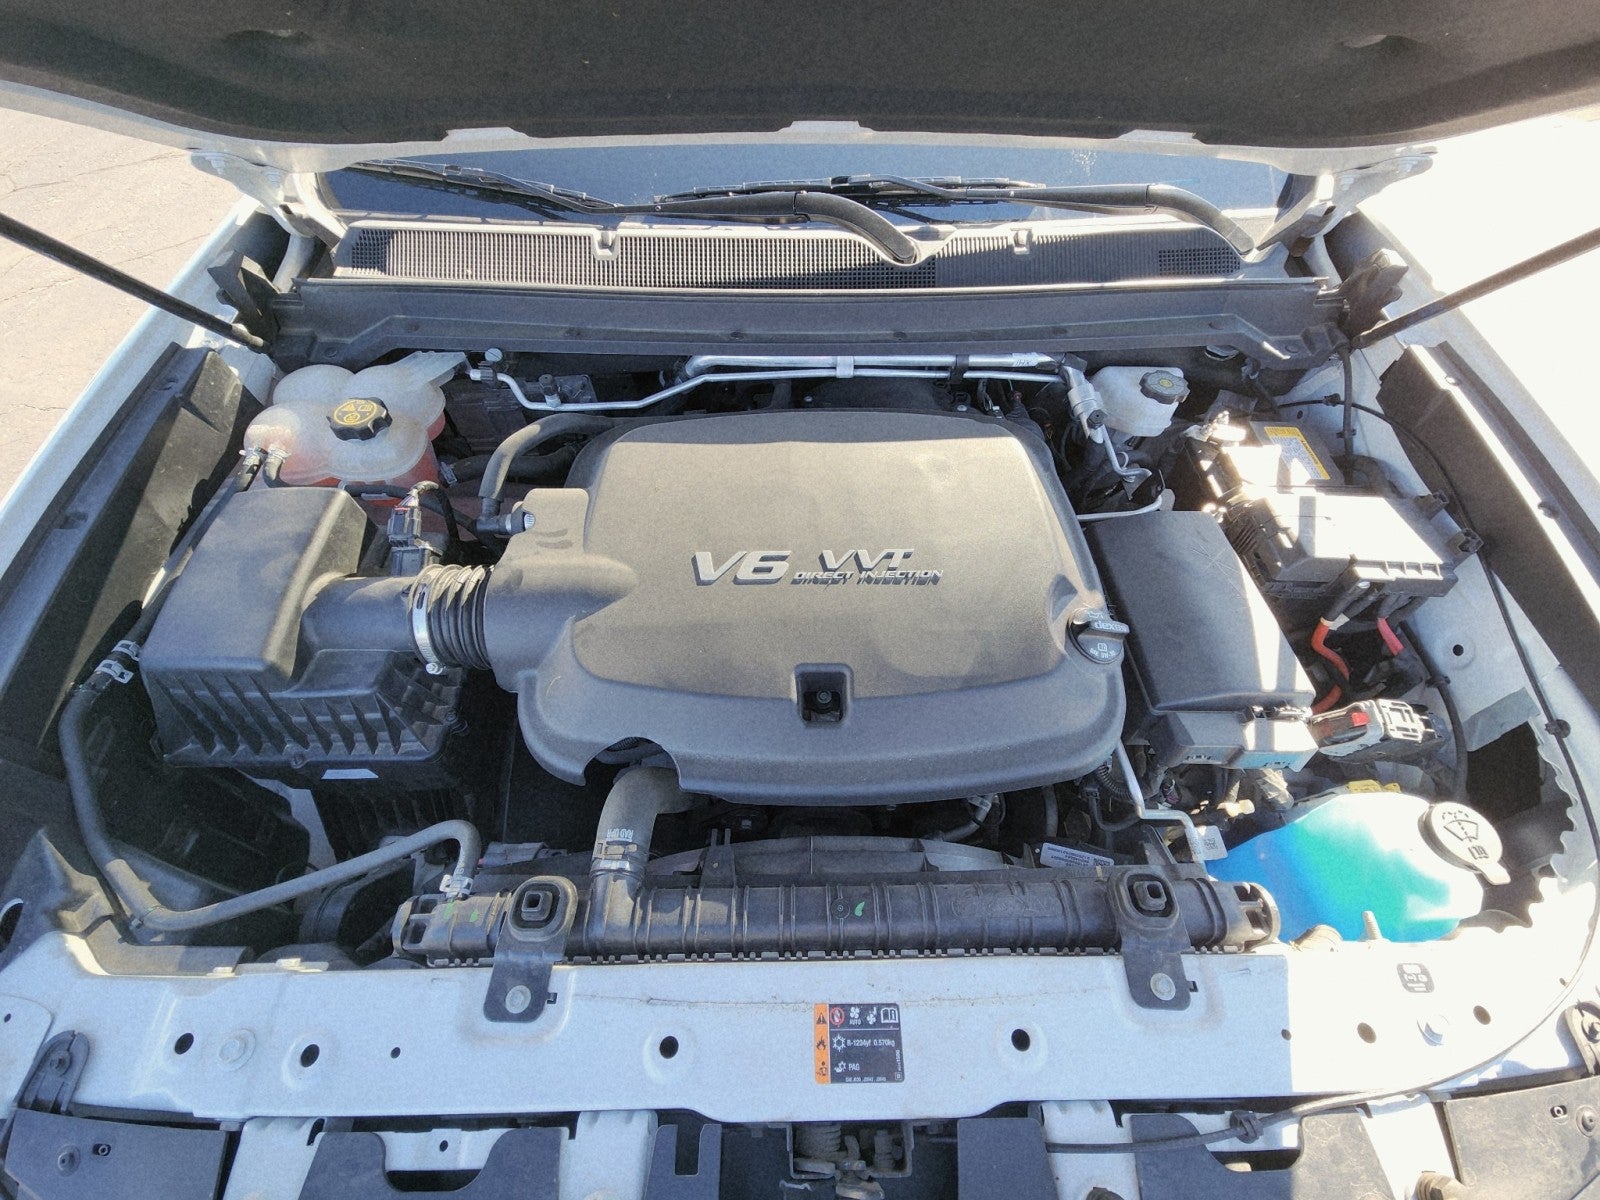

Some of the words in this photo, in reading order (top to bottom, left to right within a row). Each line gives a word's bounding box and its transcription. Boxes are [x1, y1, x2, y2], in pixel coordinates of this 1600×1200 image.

[691, 550, 792, 586] V6
[818, 549, 915, 573] VVT
[791, 571, 855, 583] DIRECT
[858, 569, 944, 583] INJECTION
[620, 828, 633, 838] RAD
